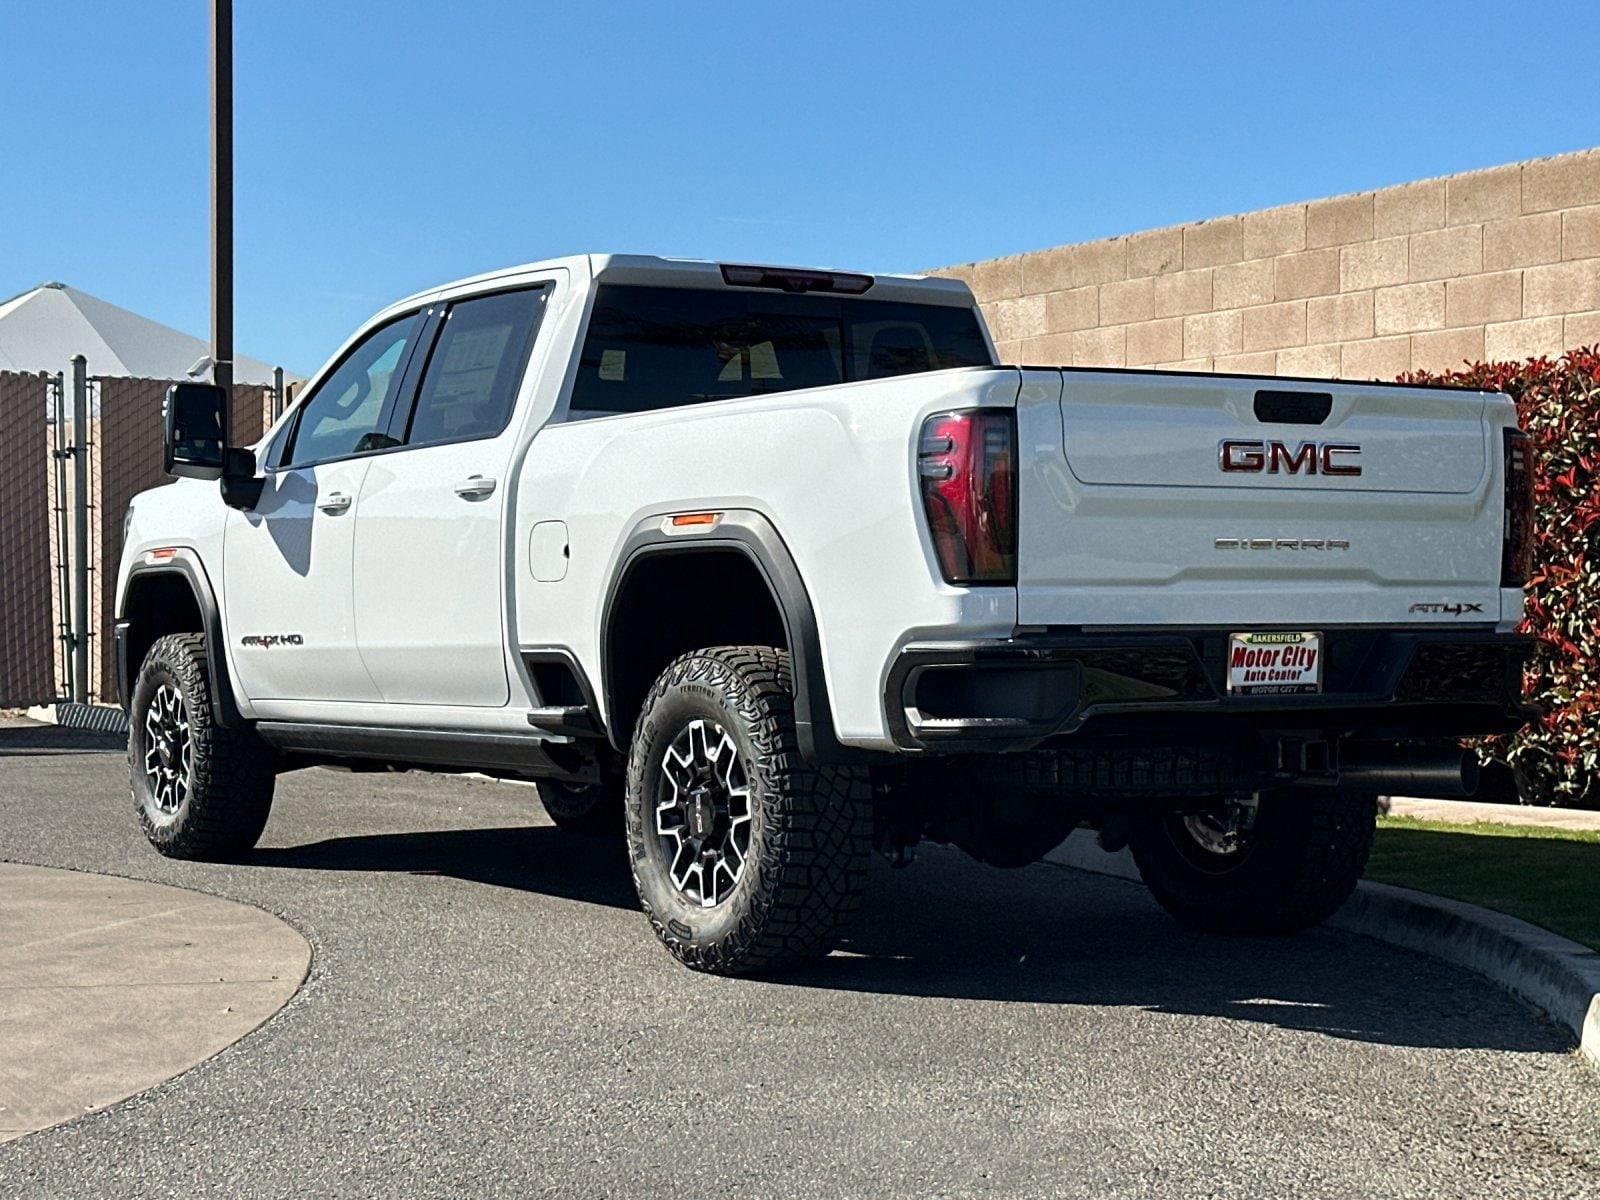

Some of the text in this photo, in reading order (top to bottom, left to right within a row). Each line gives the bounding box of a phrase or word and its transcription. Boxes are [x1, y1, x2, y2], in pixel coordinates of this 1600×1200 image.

[1218, 438, 1362, 476] GMC
[1215, 538, 1349, 550] SIERRA
[280, 635, 303, 645] HD
[1252, 634, 1301, 642] BAKERSFIELD
[1231, 645, 1317, 672] Motor City
[1243, 669, 1303, 682] Auto Center
[1251, 686, 1279, 694] MOTOR
[1280, 685, 1298, 693] CITY
